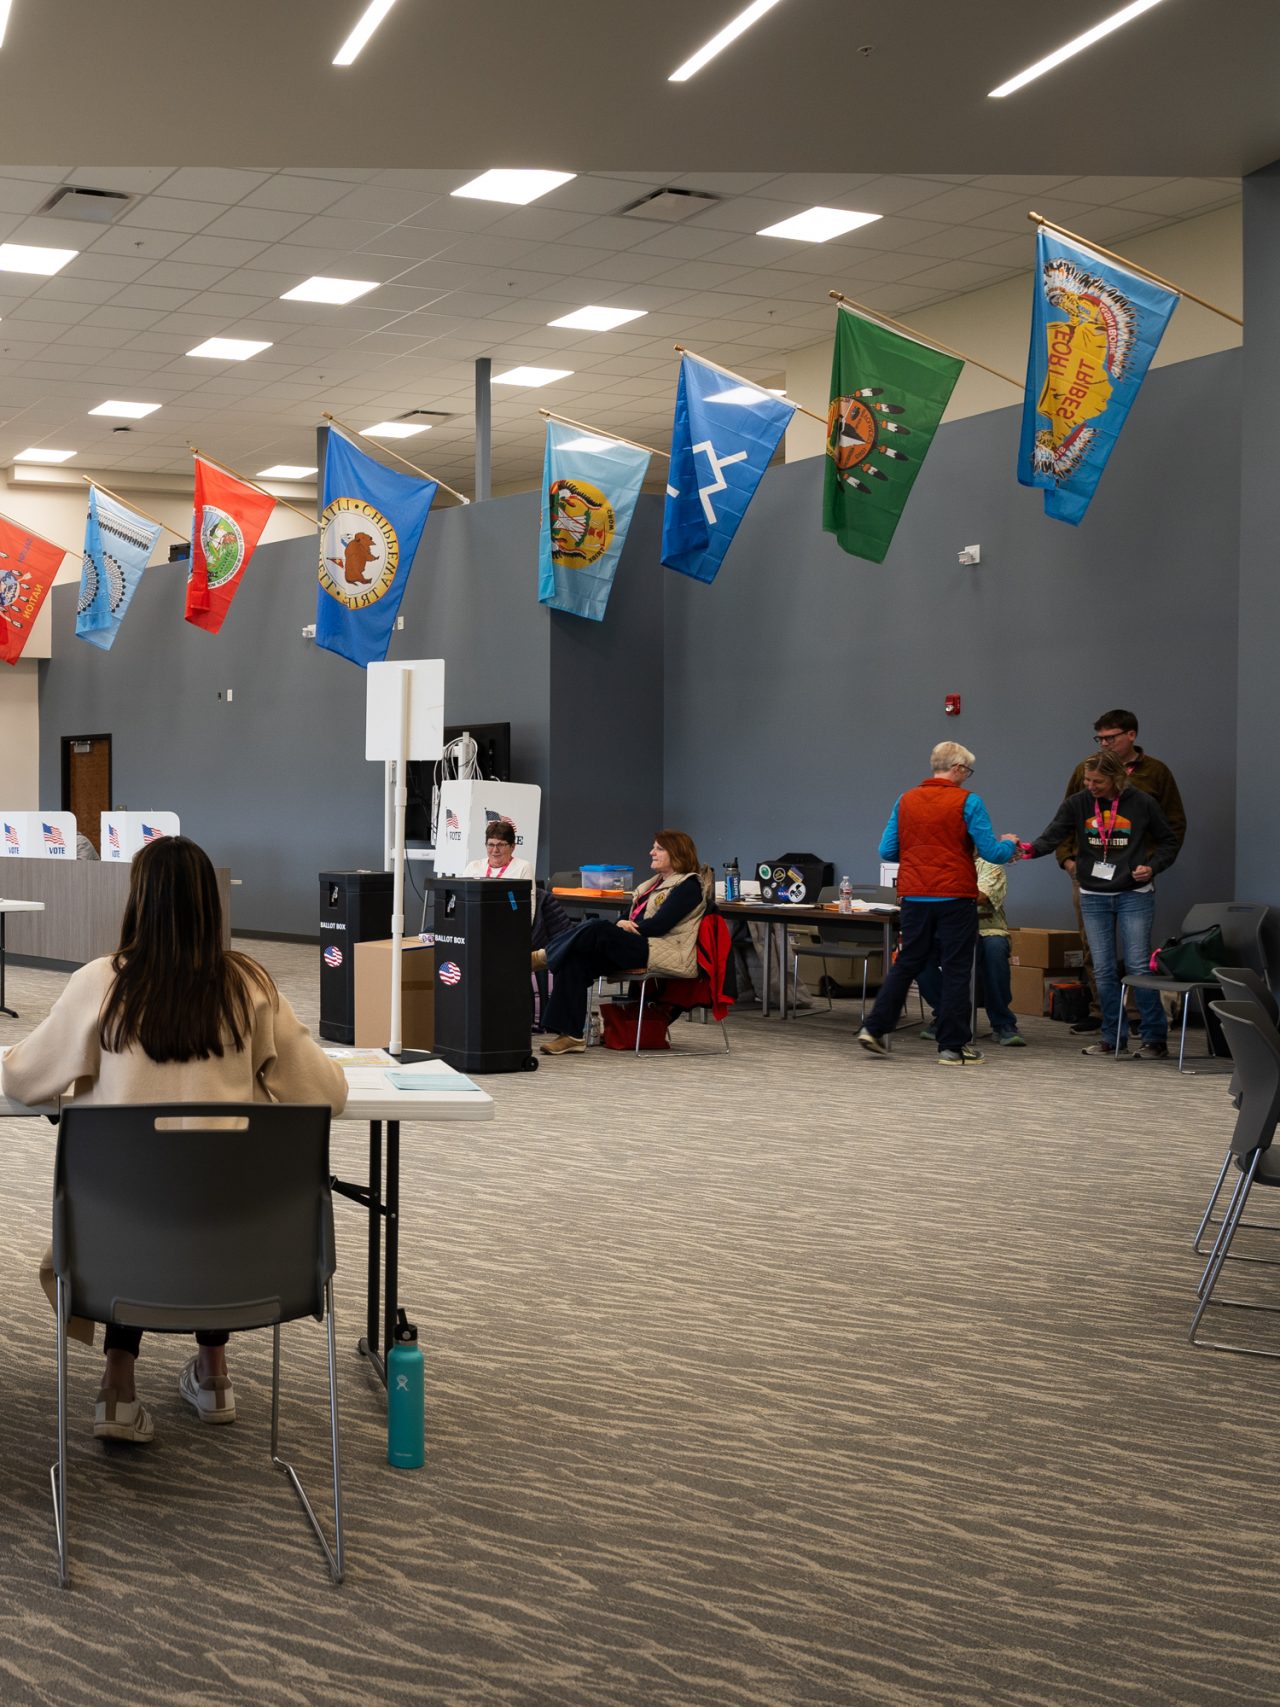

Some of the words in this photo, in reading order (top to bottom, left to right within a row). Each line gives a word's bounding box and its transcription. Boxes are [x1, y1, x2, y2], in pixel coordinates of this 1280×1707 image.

[449, 831, 462, 841] VOTE
[8, 847, 20, 855] VOTE
[49, 847, 66, 855] VOTE
[320, 922, 335, 930] BALLOT
[336, 923, 347, 931] BOX
[434, 935, 453, 944] BALLOT
[454, 936, 466, 945] BOX
